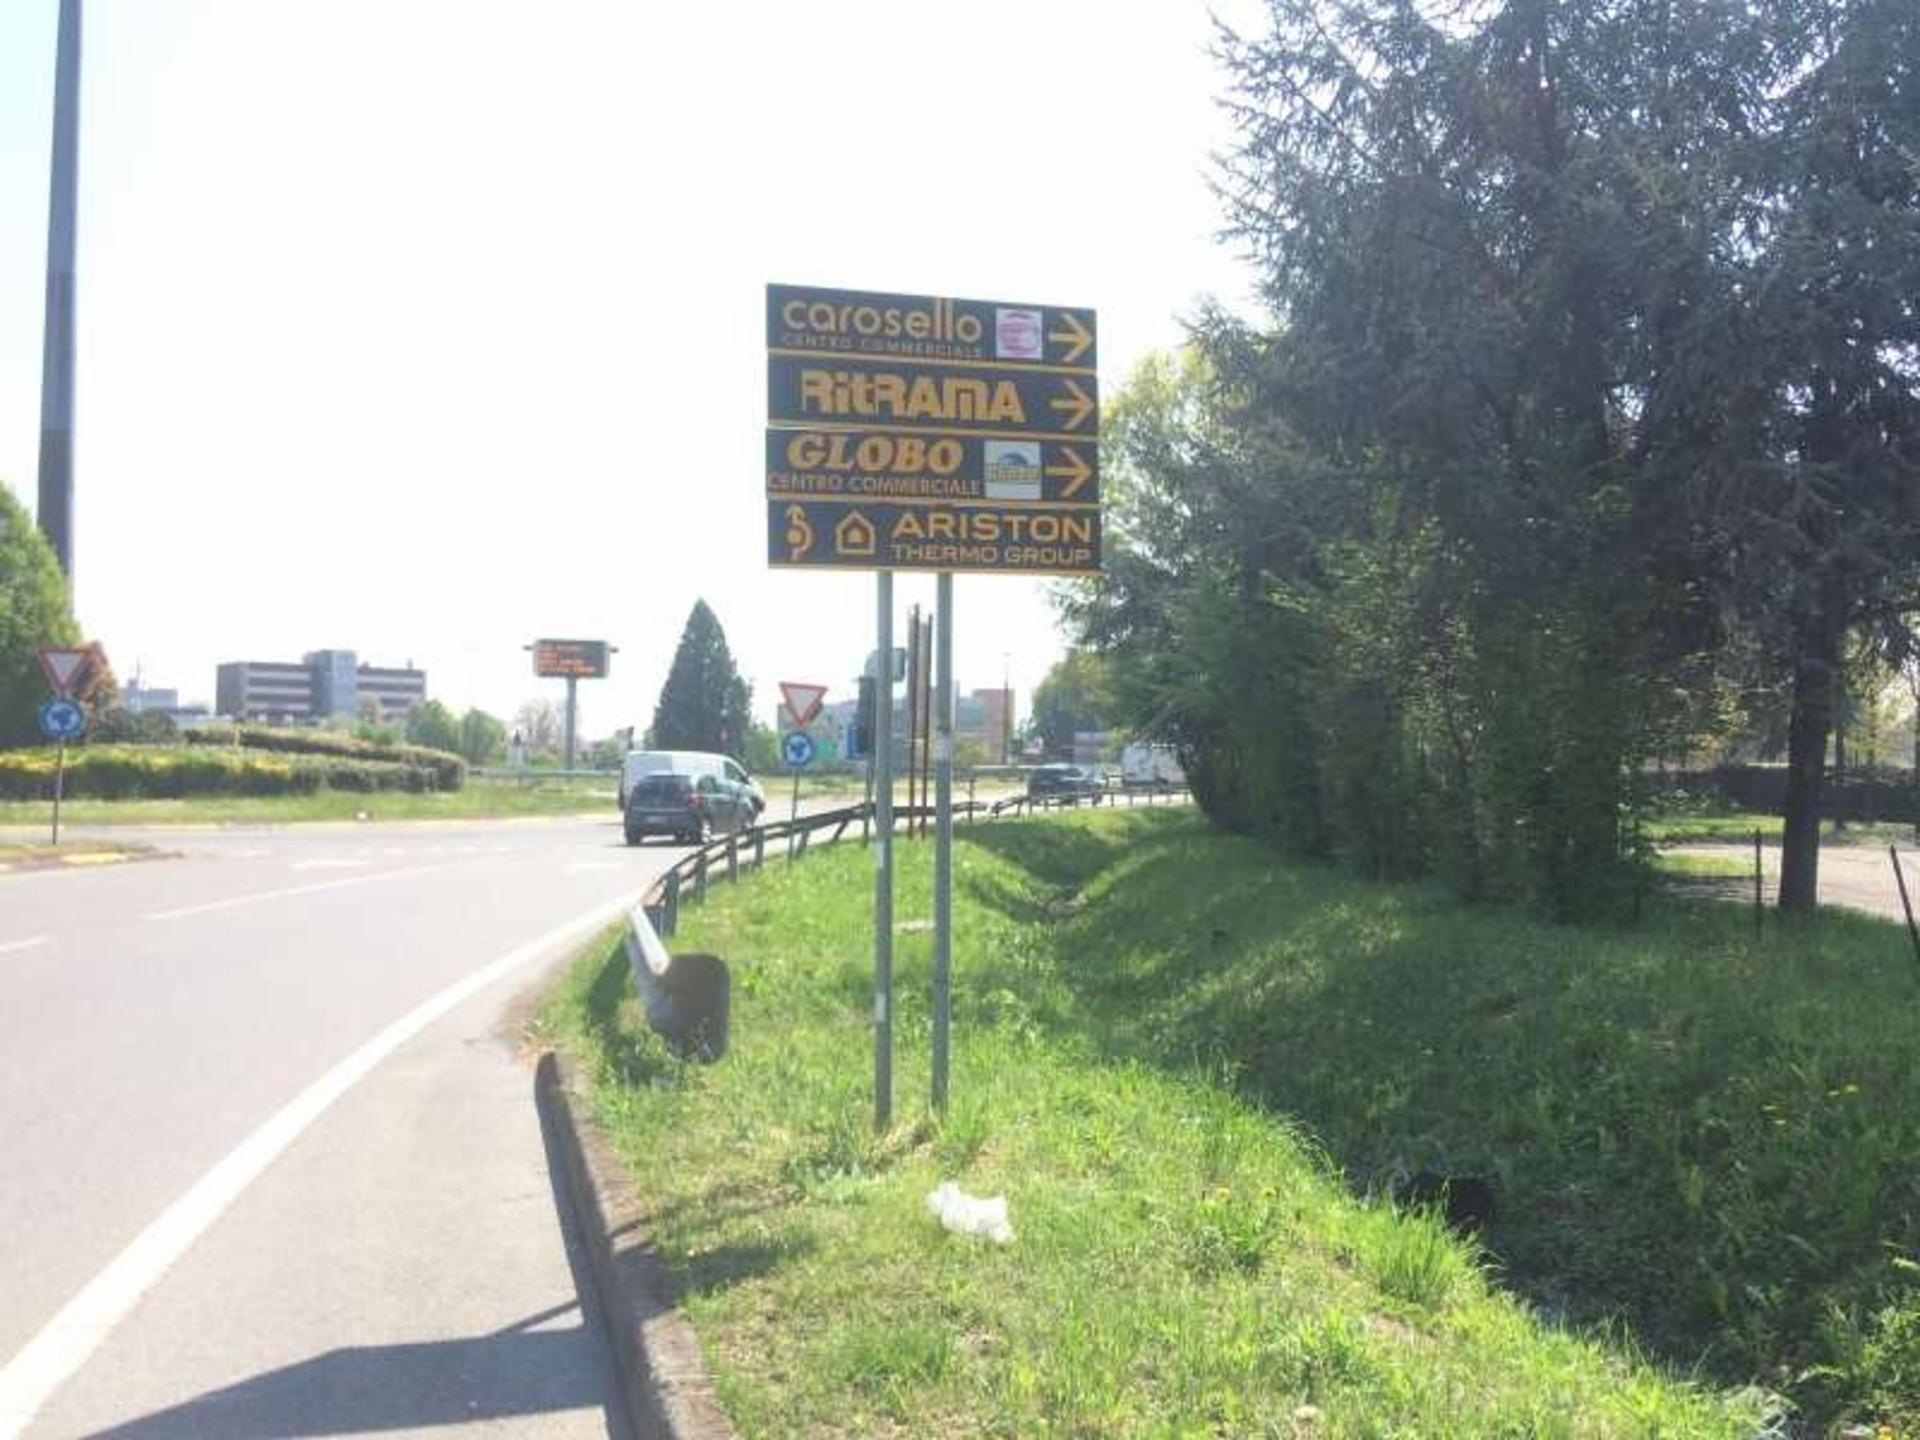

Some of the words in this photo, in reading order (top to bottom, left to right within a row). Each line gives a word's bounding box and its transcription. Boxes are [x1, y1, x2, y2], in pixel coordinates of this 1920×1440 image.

[783, 298, 982, 342] carosello
[788, 434, 963, 473] GLOBO
[767, 474, 843, 491] CENTRO
[850, 476, 980, 497] COMMERCIALE
[892, 513, 1091, 544] ARISTON
[893, 545, 998, 564] THERMO
[1005, 547, 1091, 565] GROUP
